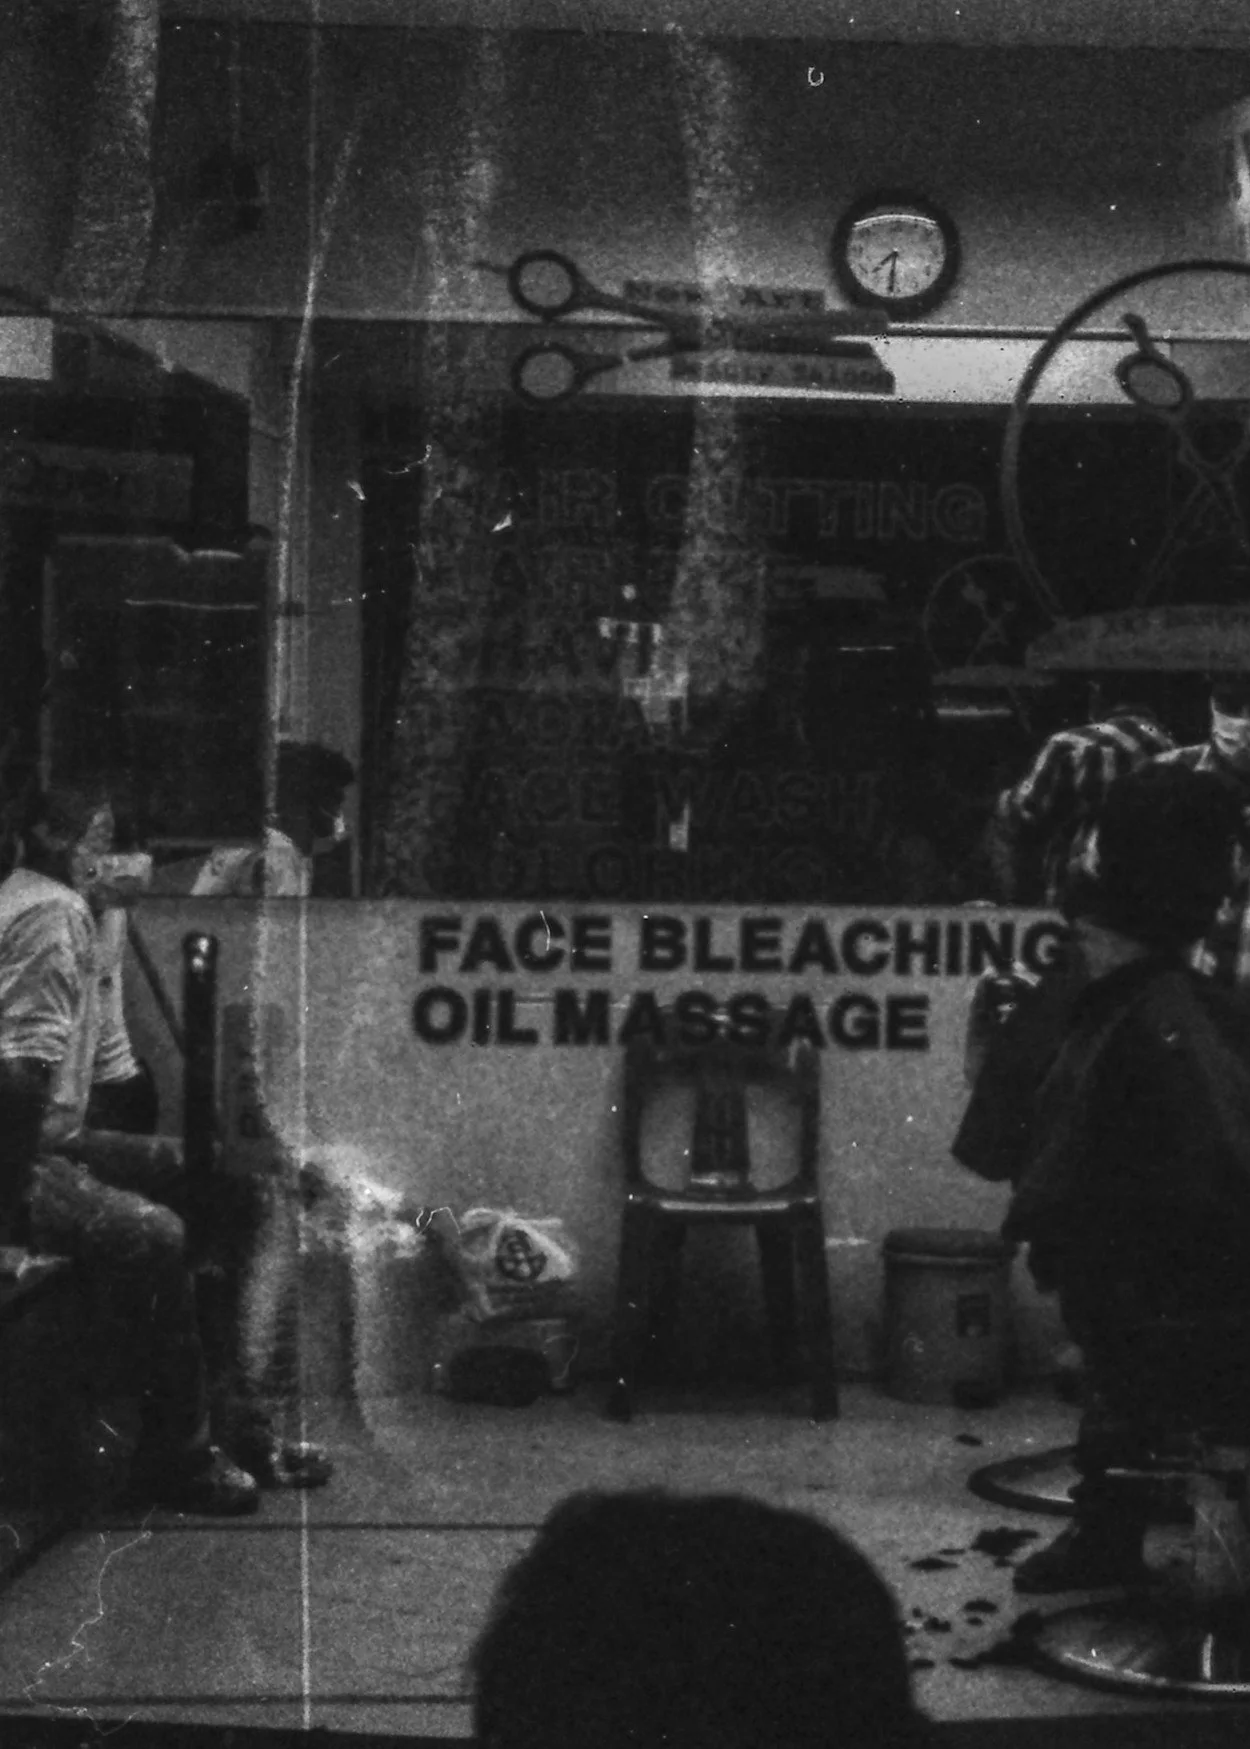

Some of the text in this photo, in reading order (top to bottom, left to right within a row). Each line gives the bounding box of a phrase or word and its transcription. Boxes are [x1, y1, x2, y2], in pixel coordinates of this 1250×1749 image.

[418, 913, 1068, 977] FACE BLEACHING
[412, 984, 932, 1051] OIL MASSAGE
